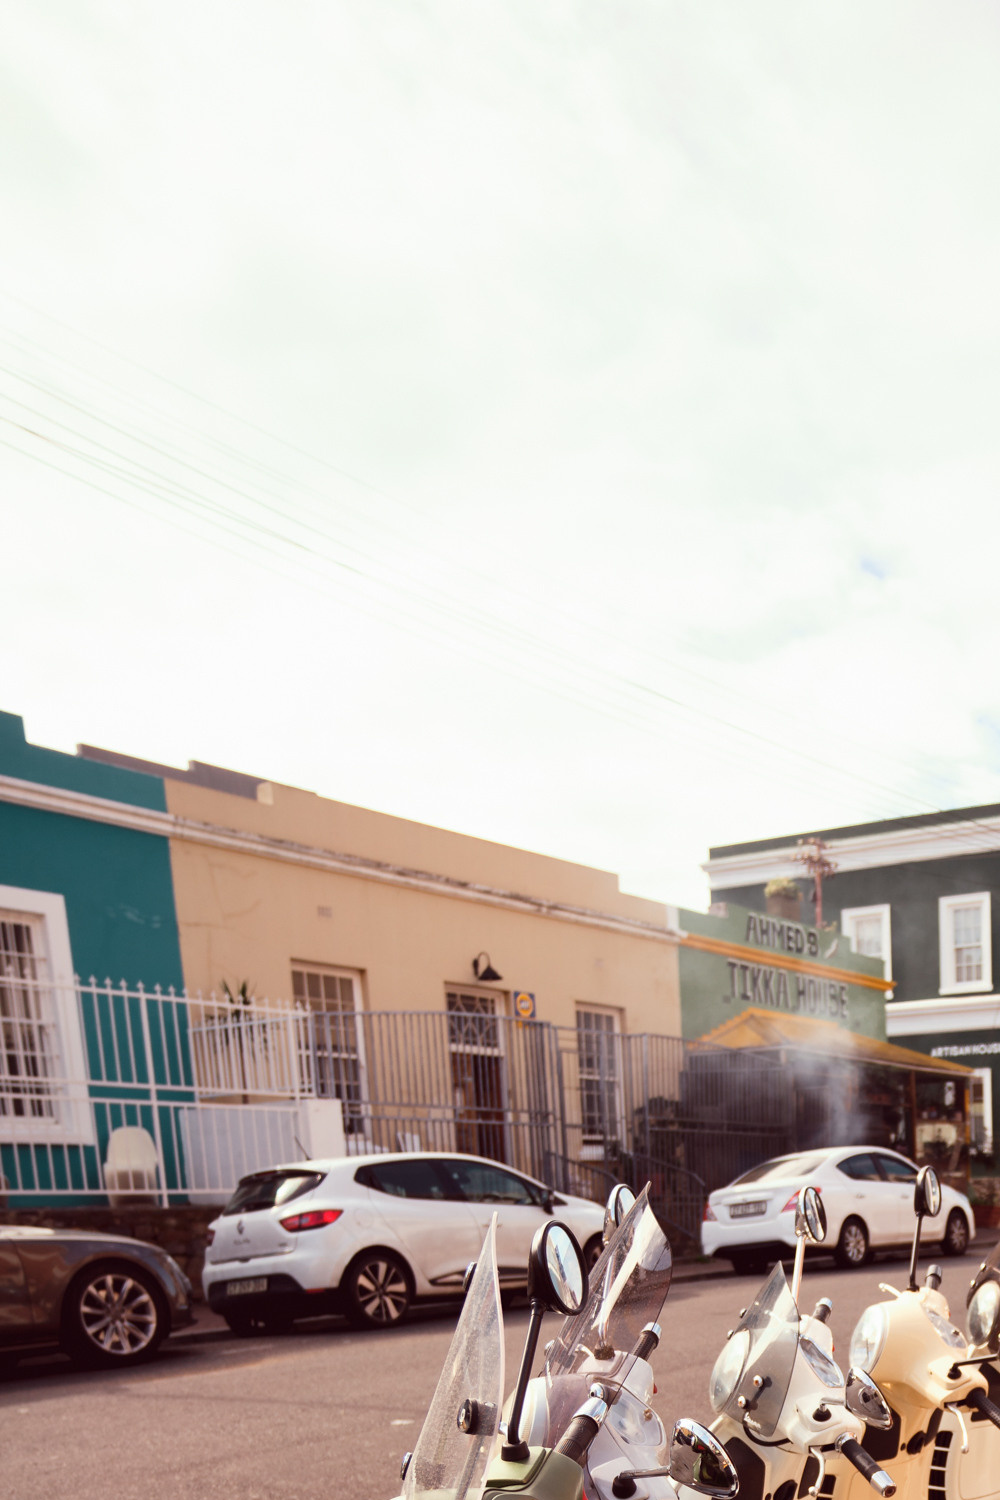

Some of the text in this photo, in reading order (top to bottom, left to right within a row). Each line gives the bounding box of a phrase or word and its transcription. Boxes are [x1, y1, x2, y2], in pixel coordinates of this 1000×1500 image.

[727, 958, 848, 1019] TIKKA HOUSE
[930, 1044, 971, 1058] ARTISAN
